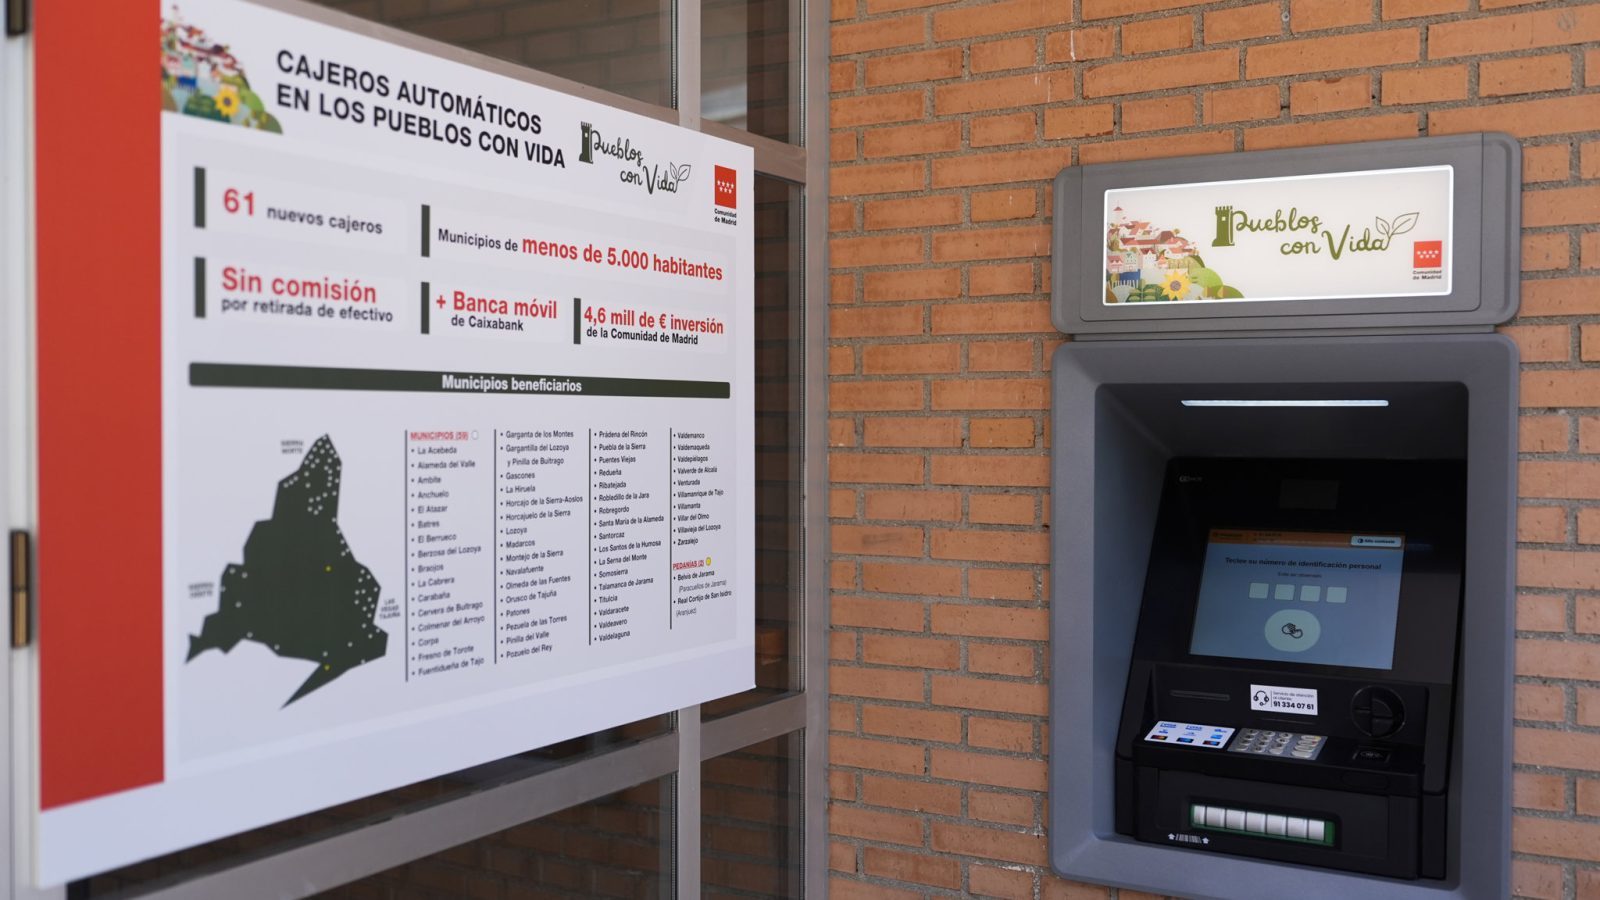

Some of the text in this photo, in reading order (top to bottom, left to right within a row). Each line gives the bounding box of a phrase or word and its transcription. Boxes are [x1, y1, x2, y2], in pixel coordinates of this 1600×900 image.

[277, 50, 541, 134] CAJEROS AUTOMÁTICOS
[277, 84, 564, 168] EN LOS PUEBLOS CON VIDA
[579, 121, 644, 166] Pueblos
[620, 164, 678, 194] con Vida
[223, 188, 255, 215] 61
[714, 208, 737, 218] Comunidad
[267, 207, 382, 234] nuevos cajeros
[721, 217, 737, 226] Madrid
[1212, 206, 1322, 247] Pueblos
[438, 228, 517, 251] Municipios de
[1280, 224, 1390, 260] con Vida
[522, 238, 722, 280] menos de 5.000 habitantes
[222, 266, 376, 310] Sin comisión
[221, 298, 392, 322] por retirada de efectivo
[436, 291, 556, 322] + Banca móvil
[451, 314, 523, 330] de Caixabank
[584, 306, 724, 334] 4,6 mill de € inversión
[586, 326, 698, 344] de la Comunidad de Madrid
[442, 374, 582, 394] Municipios beneficiarios
[410, 432, 454, 440] MUNICIPIOS
[506, 430, 533, 439] Garganta
[506, 444, 537, 453] Gargantilla
[549, 444, 569, 452] Lozoya
[540, 457, 564, 465] Buitrago
[599, 481, 626, 489] Ribatejada
[599, 505, 629, 514] Robregordo
[506, 512, 537, 520] Horcajuelo
[506, 565, 543, 575] Navalafuente
[599, 569, 628, 578] Somosierra
[599, 581, 626, 590] Talamanca
[505, 595, 527, 603] Orusco
[537, 590, 556, 599] Tajuña
[599, 595, 617, 603] Titulcia
[506, 608, 529, 616] Patones
[598, 606, 629, 616] Valdaracete
[598, 619, 627, 628] Valdeavero
[599, 631, 630, 641] Valdelaguna
[506, 648, 529, 658] Pozuelo
